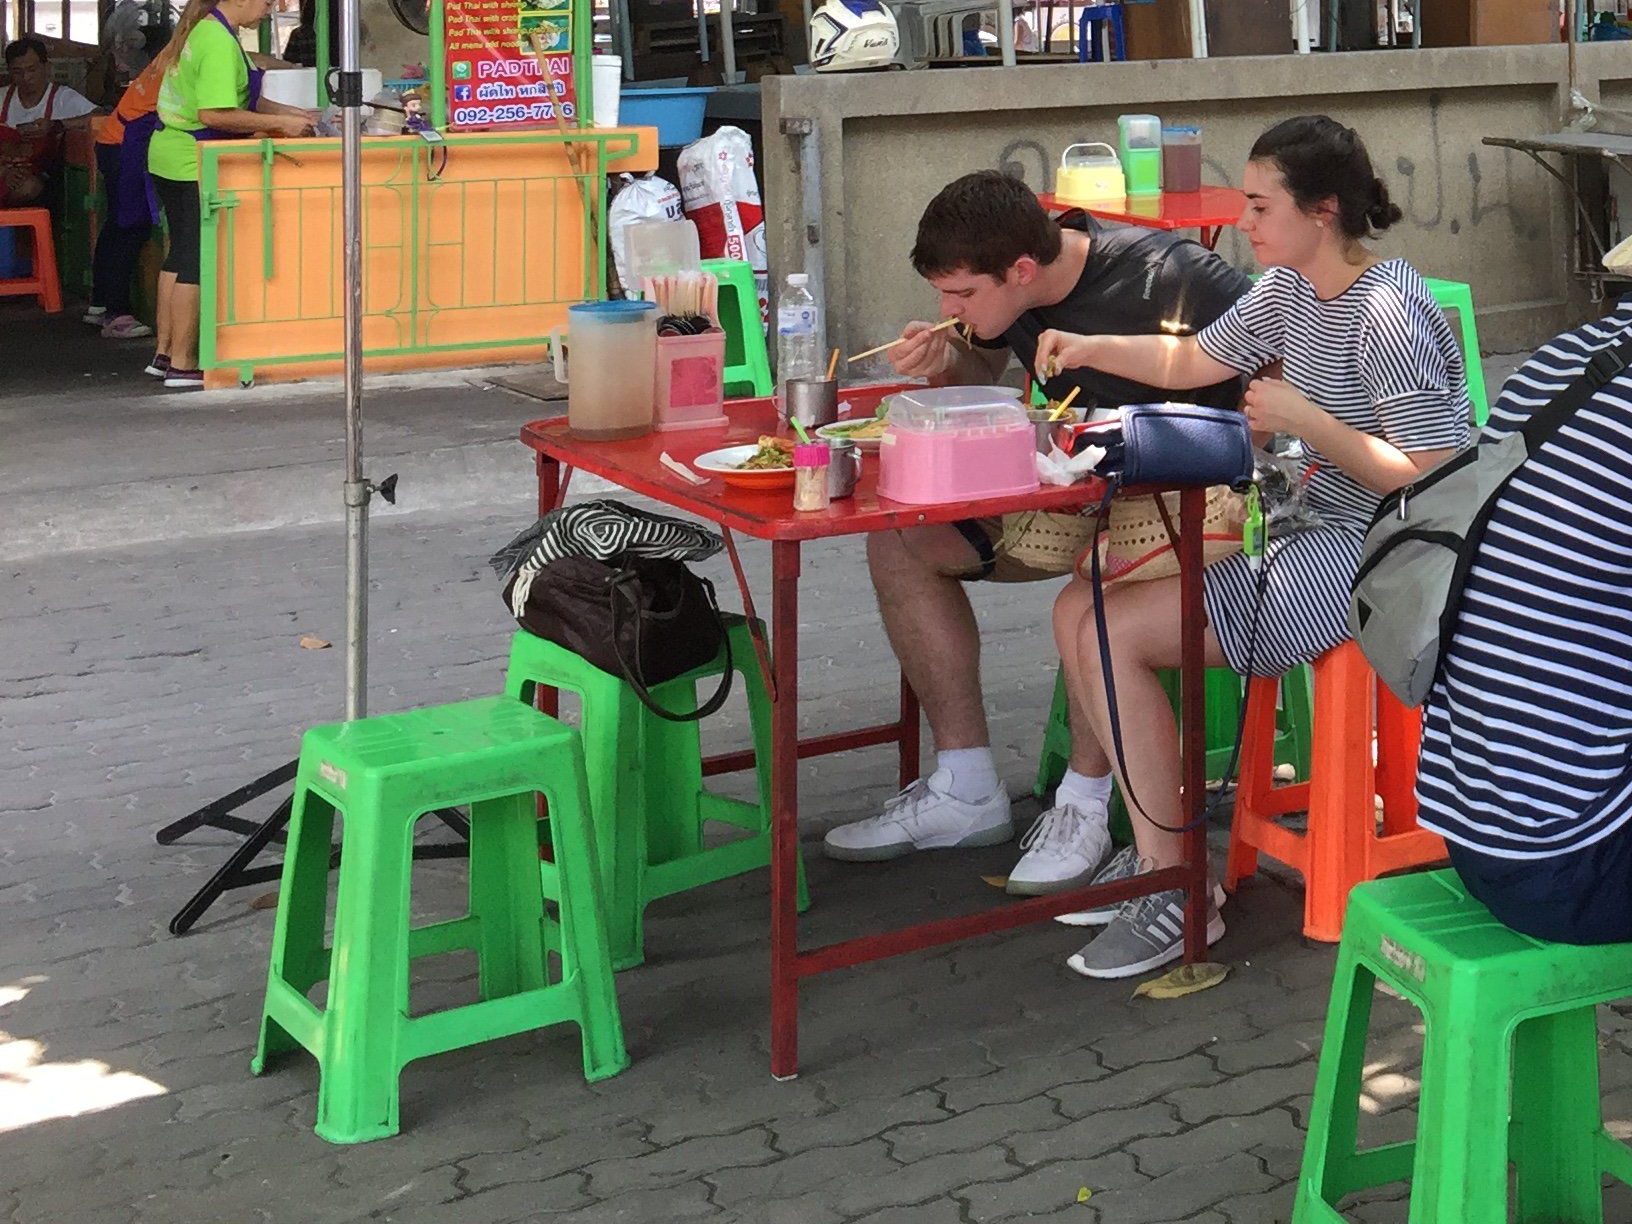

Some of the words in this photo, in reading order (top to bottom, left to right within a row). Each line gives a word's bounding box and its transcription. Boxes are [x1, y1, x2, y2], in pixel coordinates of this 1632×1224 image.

[518, 80, 565, 98] หกสิปี
[457, 104, 573, 123] 092-256-776
